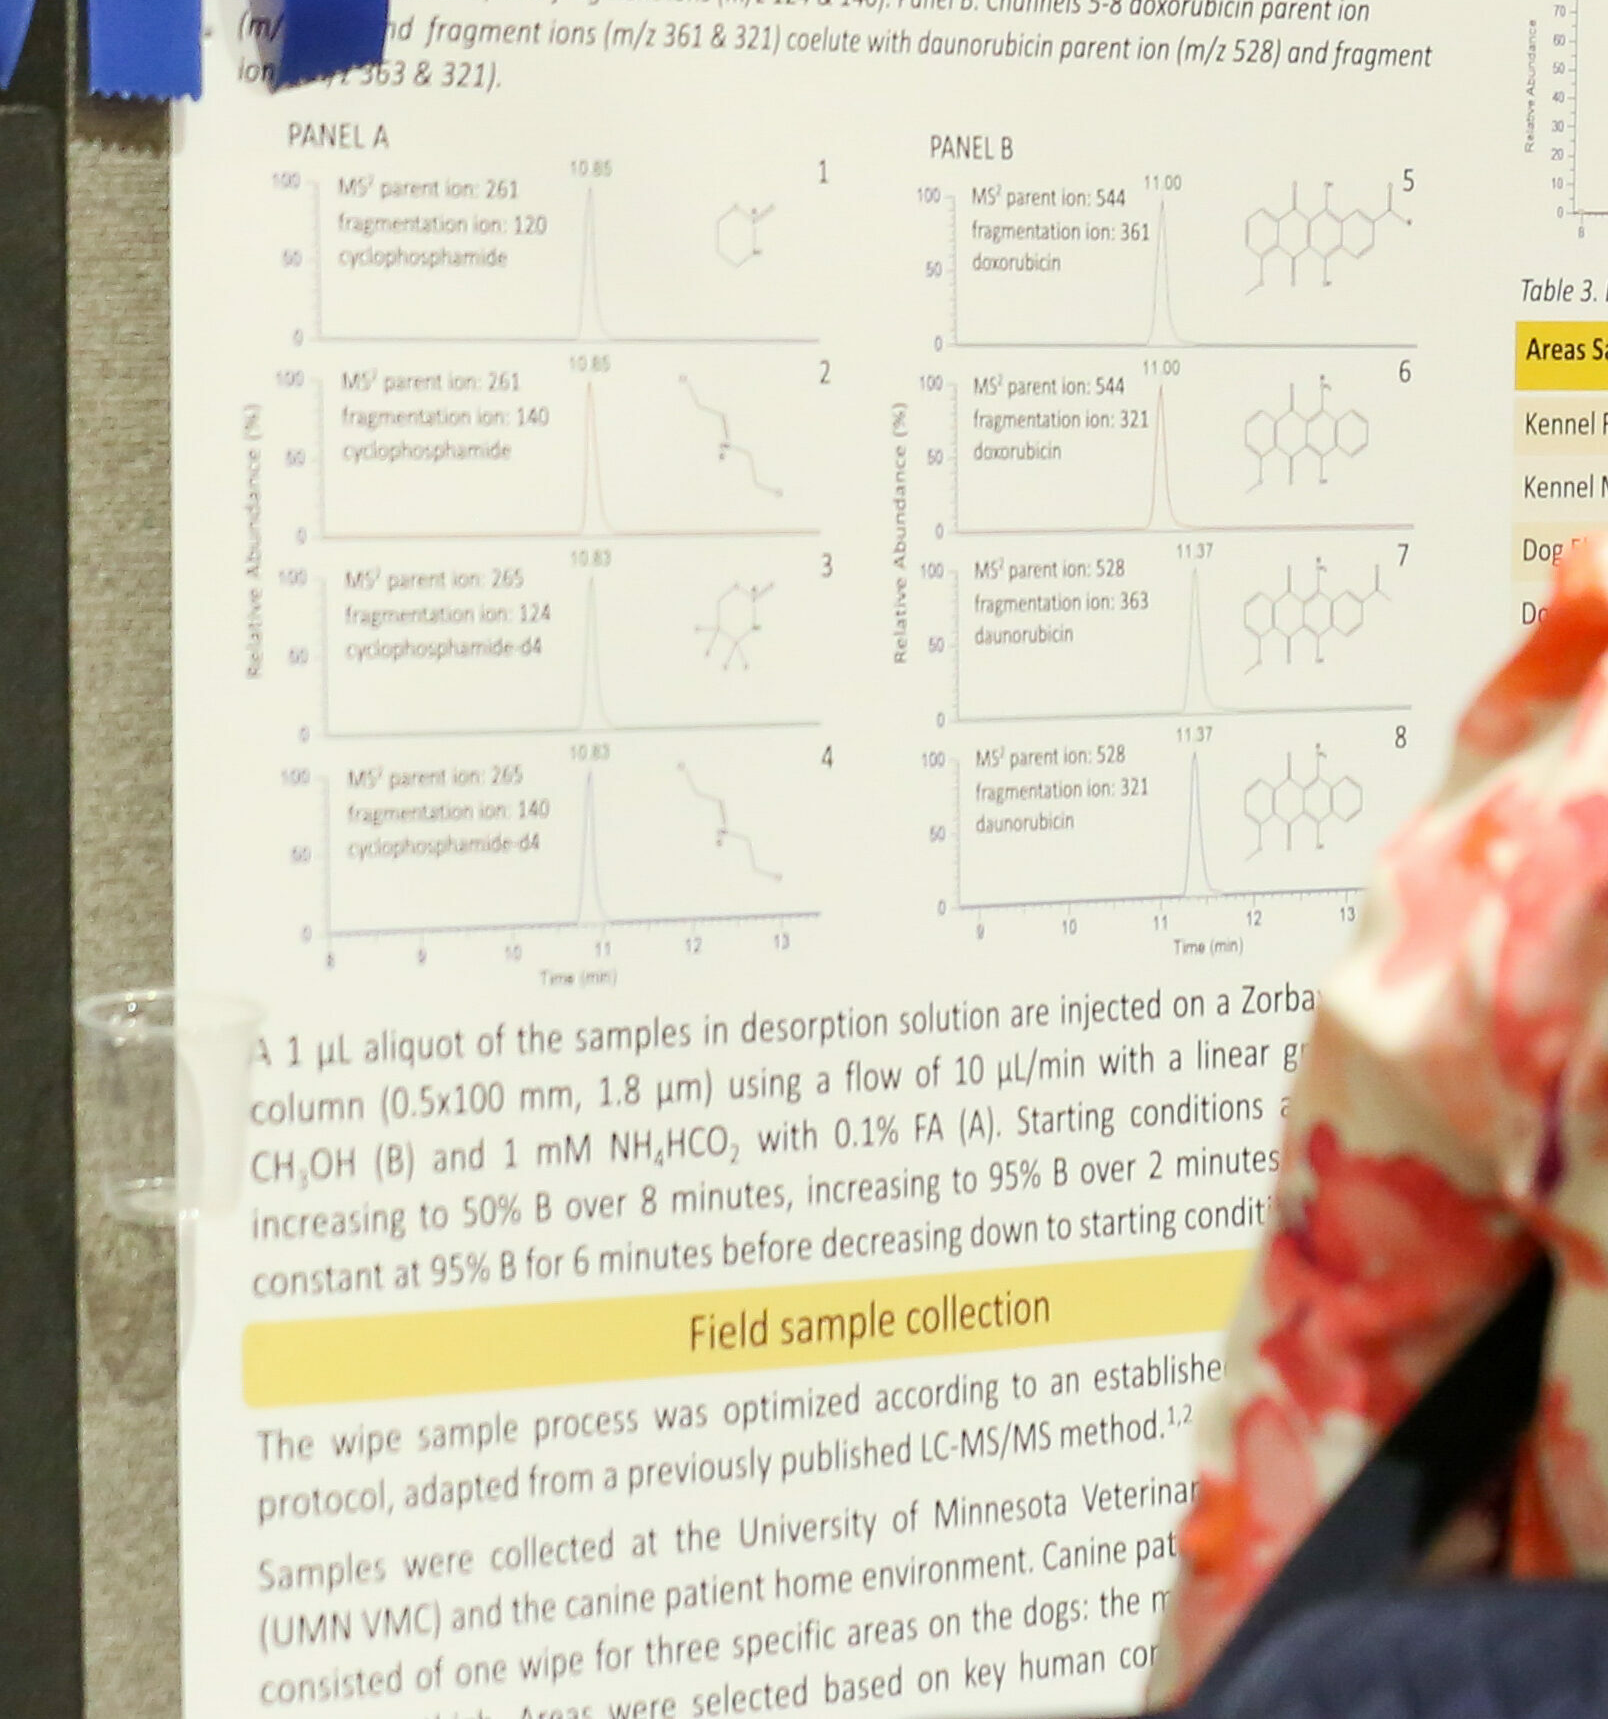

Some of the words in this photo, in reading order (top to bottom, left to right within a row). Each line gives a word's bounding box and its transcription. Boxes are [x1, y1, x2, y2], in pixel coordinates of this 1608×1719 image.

[930, 134, 995, 161] PANEL
[1001, 135, 1014, 161] B
[1525, 337, 1586, 361] Areas
[1525, 410, 1596, 436] Kennel
[1524, 473, 1595, 499] Kennel
[690, 1307, 769, 1352] Field
[780, 1299, 896, 1350] sample
[906, 1289, 1050, 1335] collection
[258, 1478, 394, 1527] protocol,
[404, 1466, 519, 1511] adapted
[528, 1463, 594, 1497] from
[603, 1466, 618, 1491] a
[627, 1445, 773, 1496] previously
[781, 1431, 911, 1484] published
[921, 1419, 1052, 1464] LC-MS/MS
